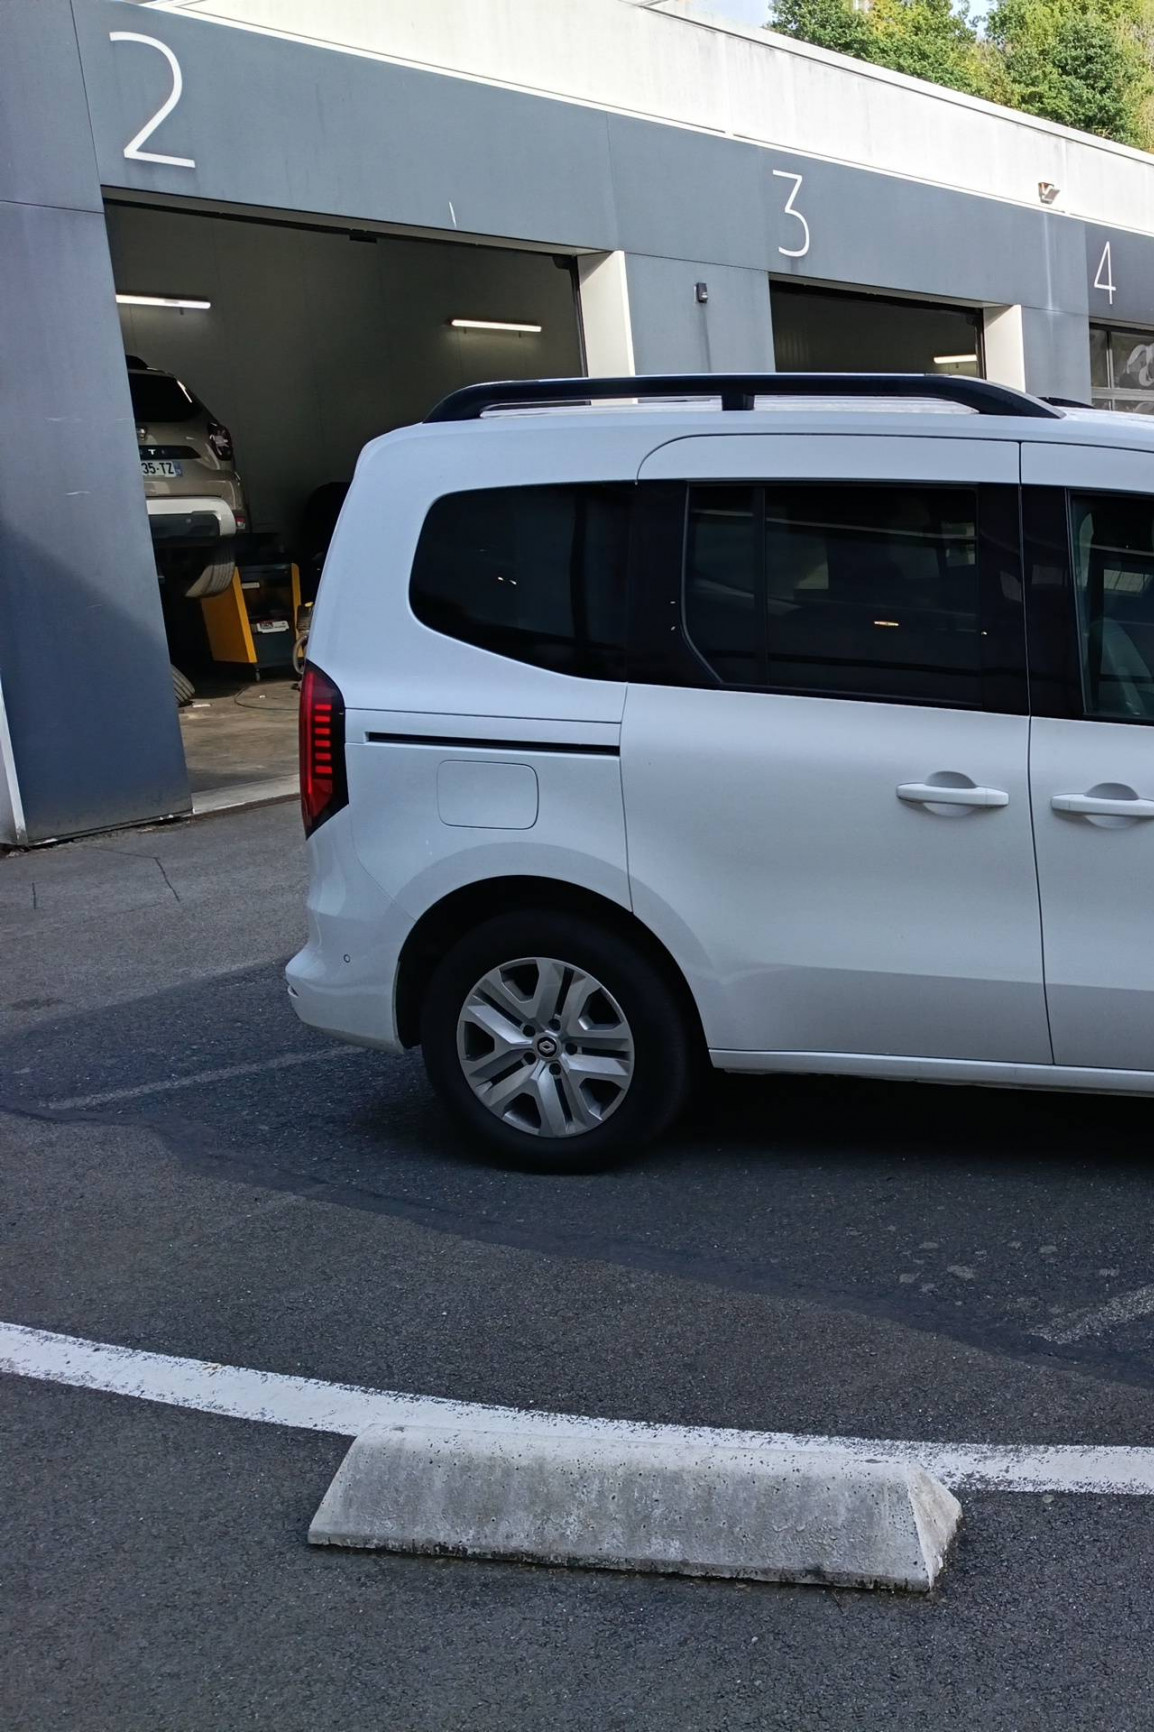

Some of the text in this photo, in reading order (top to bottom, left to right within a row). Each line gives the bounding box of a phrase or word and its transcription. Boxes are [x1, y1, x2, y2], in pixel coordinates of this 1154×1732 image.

[109, 31, 196, 169] 2
[772, 169, 810, 258] 3
[1093, 240, 1117, 305] 4
